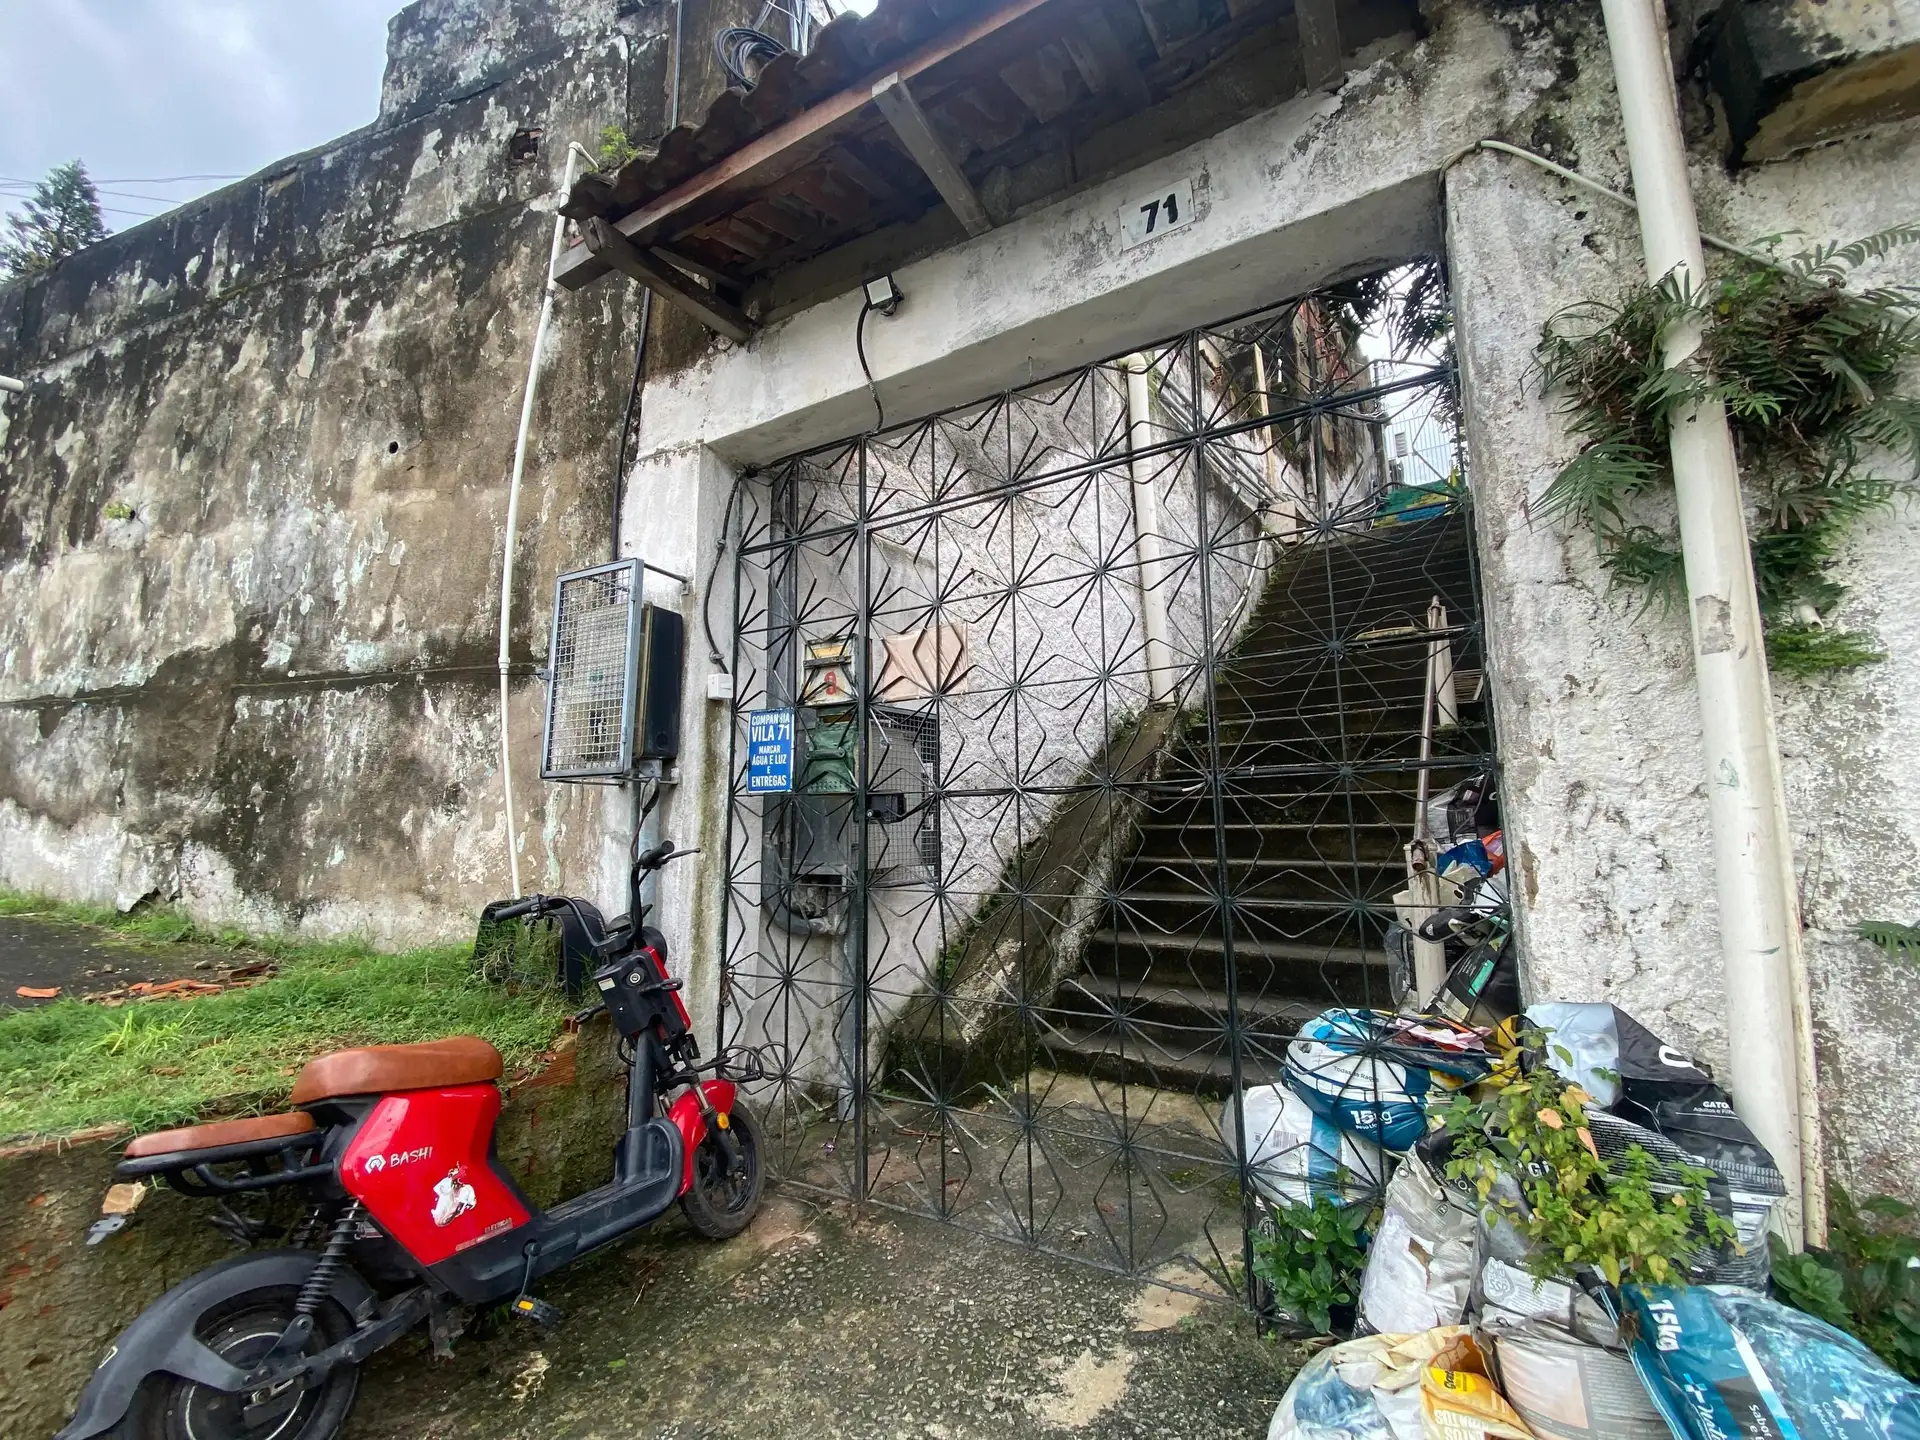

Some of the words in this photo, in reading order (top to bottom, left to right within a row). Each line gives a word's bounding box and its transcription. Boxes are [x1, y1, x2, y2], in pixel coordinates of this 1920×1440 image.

[1141, 193, 1178, 234] 71
[752, 713, 790, 726] COMPANHIA
[752, 725, 775, 742] VILA
[777, 724, 790, 741] 71
[758, 745, 781, 754] MARCAR
[752, 754, 768, 766] ÁGUA
[769, 755, 774, 764] E
[775, 754, 787, 765] LUZ
[766, 766, 771, 774] E
[751, 775, 787, 787] ENTREGAS
[1703, 1101, 1731, 1109] GATO
[390, 1146, 433, 1168] BASHI
[1647, 1299, 1682, 1351] 15kg
[1748, 1404, 1773, 1438] Sabor
